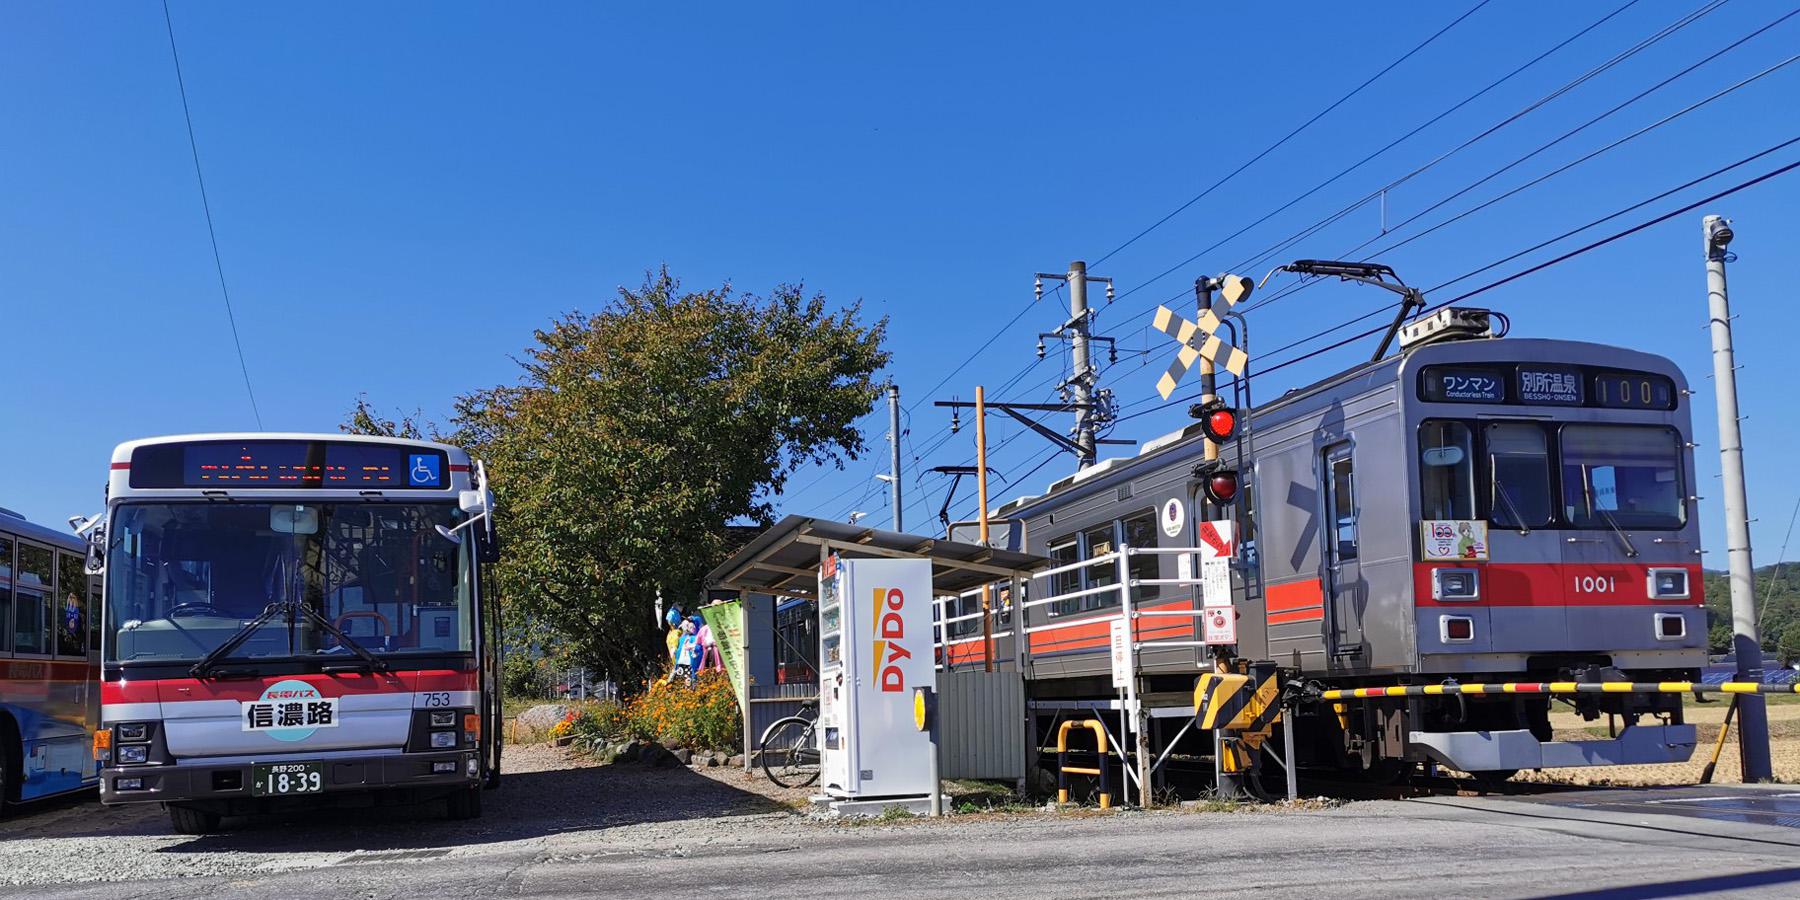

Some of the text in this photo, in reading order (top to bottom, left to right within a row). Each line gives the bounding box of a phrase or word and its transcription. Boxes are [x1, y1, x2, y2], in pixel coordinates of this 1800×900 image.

[1443, 376, 1495, 391] ワンマン
[1522, 372, 1577, 393] 別所温泉
[1574, 576, 1615, 593] 1001
[882, 588, 912, 692] DyDo
[267, 689, 315, 699] 長電バス
[423, 692, 450, 707] 753
[247, 701, 333, 728] 信濃路
[268, 771, 320, 793] 18-39
